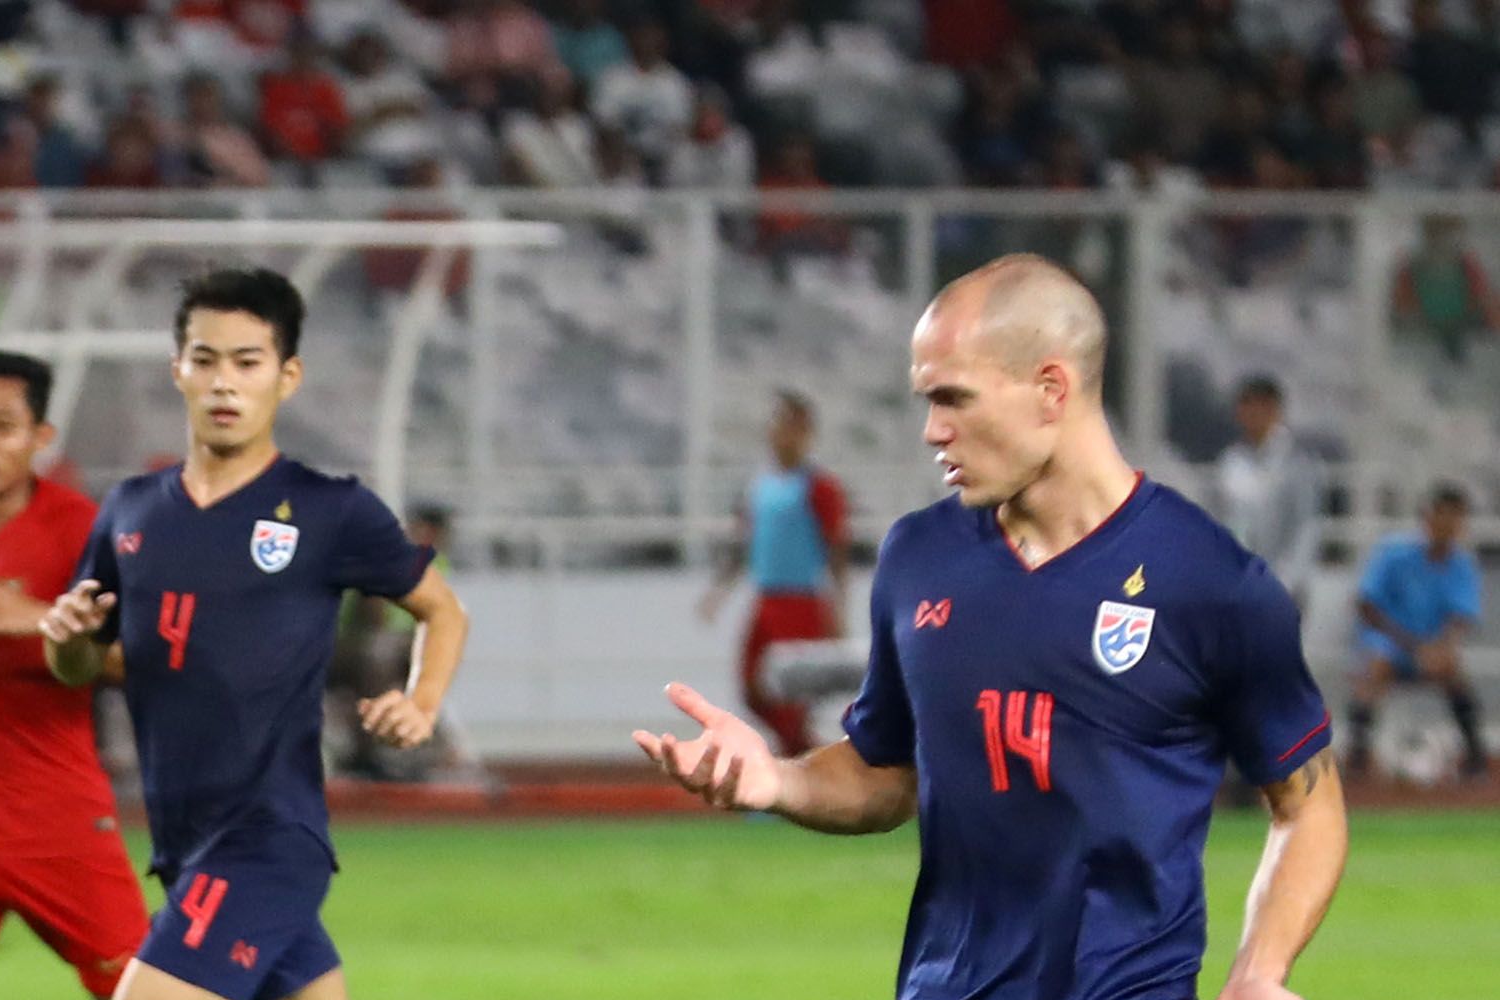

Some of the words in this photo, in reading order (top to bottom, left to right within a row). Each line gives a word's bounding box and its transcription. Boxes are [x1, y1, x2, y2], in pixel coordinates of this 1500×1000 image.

[158, 591, 196, 670] 4
[975, 688, 1055, 792] 14
[181, 873, 228, 948] 4
